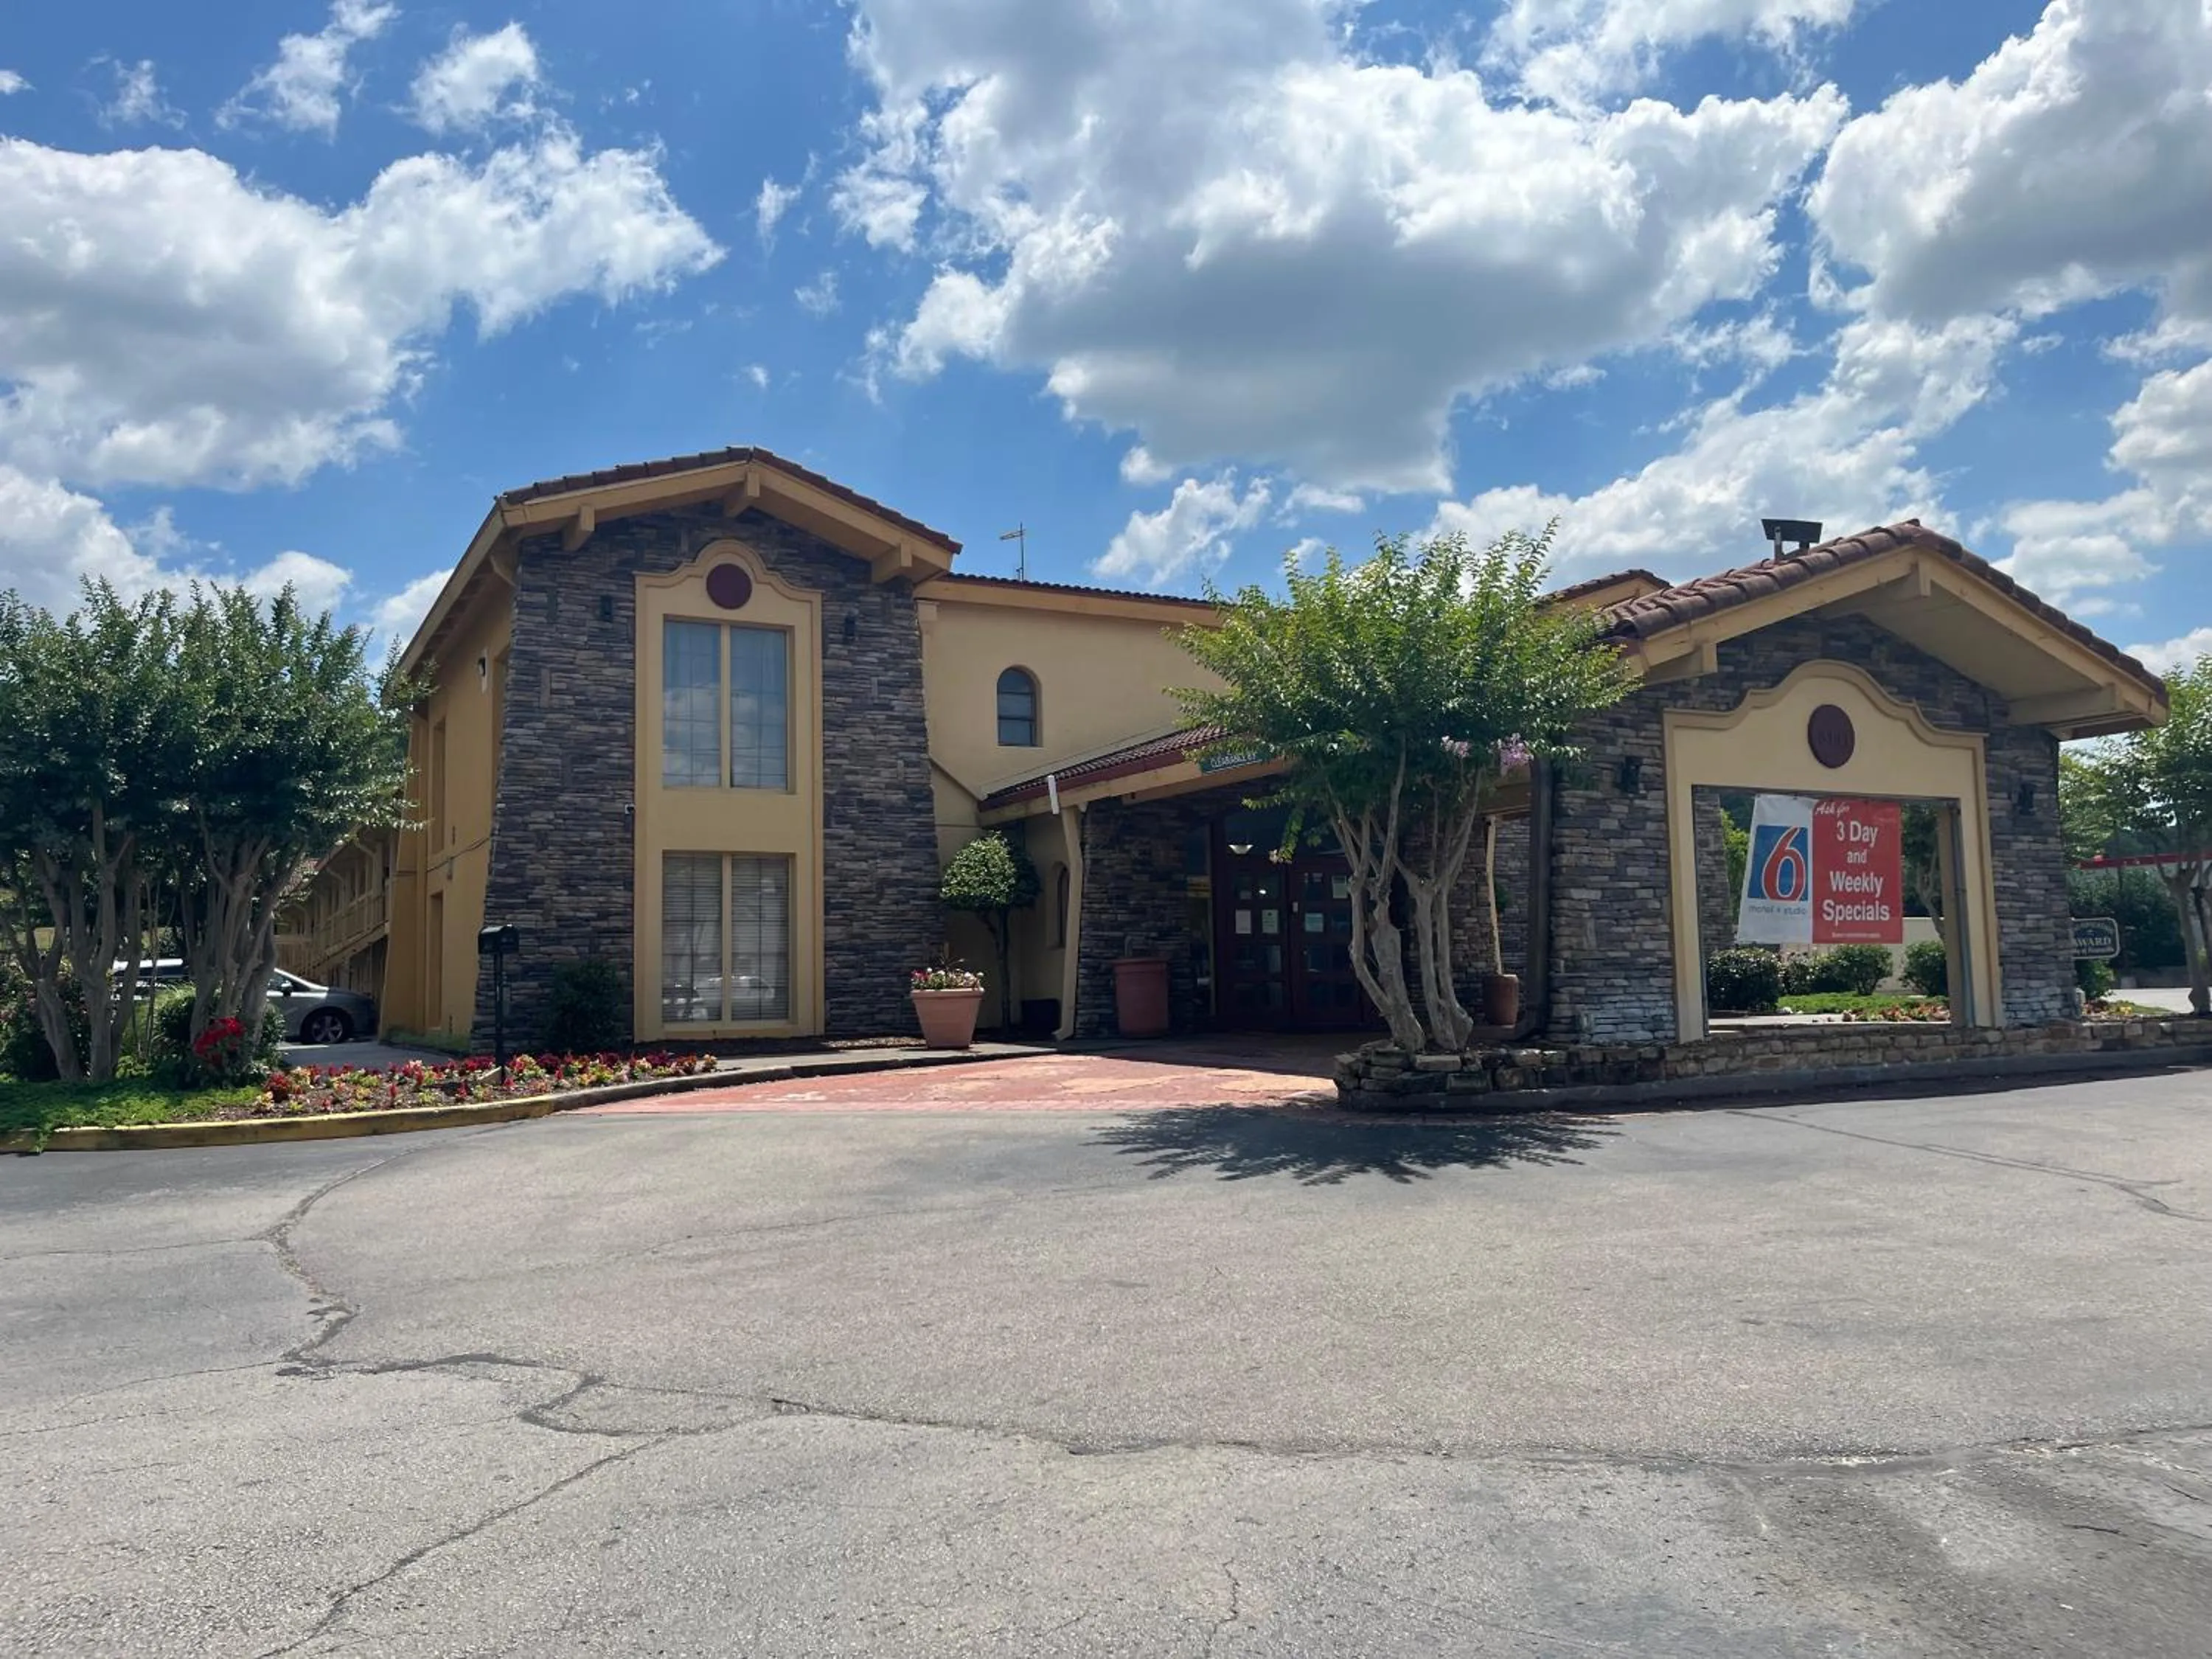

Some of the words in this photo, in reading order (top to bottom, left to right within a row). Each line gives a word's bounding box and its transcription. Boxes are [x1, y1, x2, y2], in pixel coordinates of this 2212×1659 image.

[1815, 802, 1834, 815] Ask
[1837, 802, 1850, 818] for
[1837, 821, 1845, 841] 3
[1850, 821, 1878, 848] Day
[1761, 826, 1806, 902] 6
[1846, 849, 1867, 863] and
[1829, 871, 1883, 898] Weekly
[1822, 900, 1890, 926] Specials
